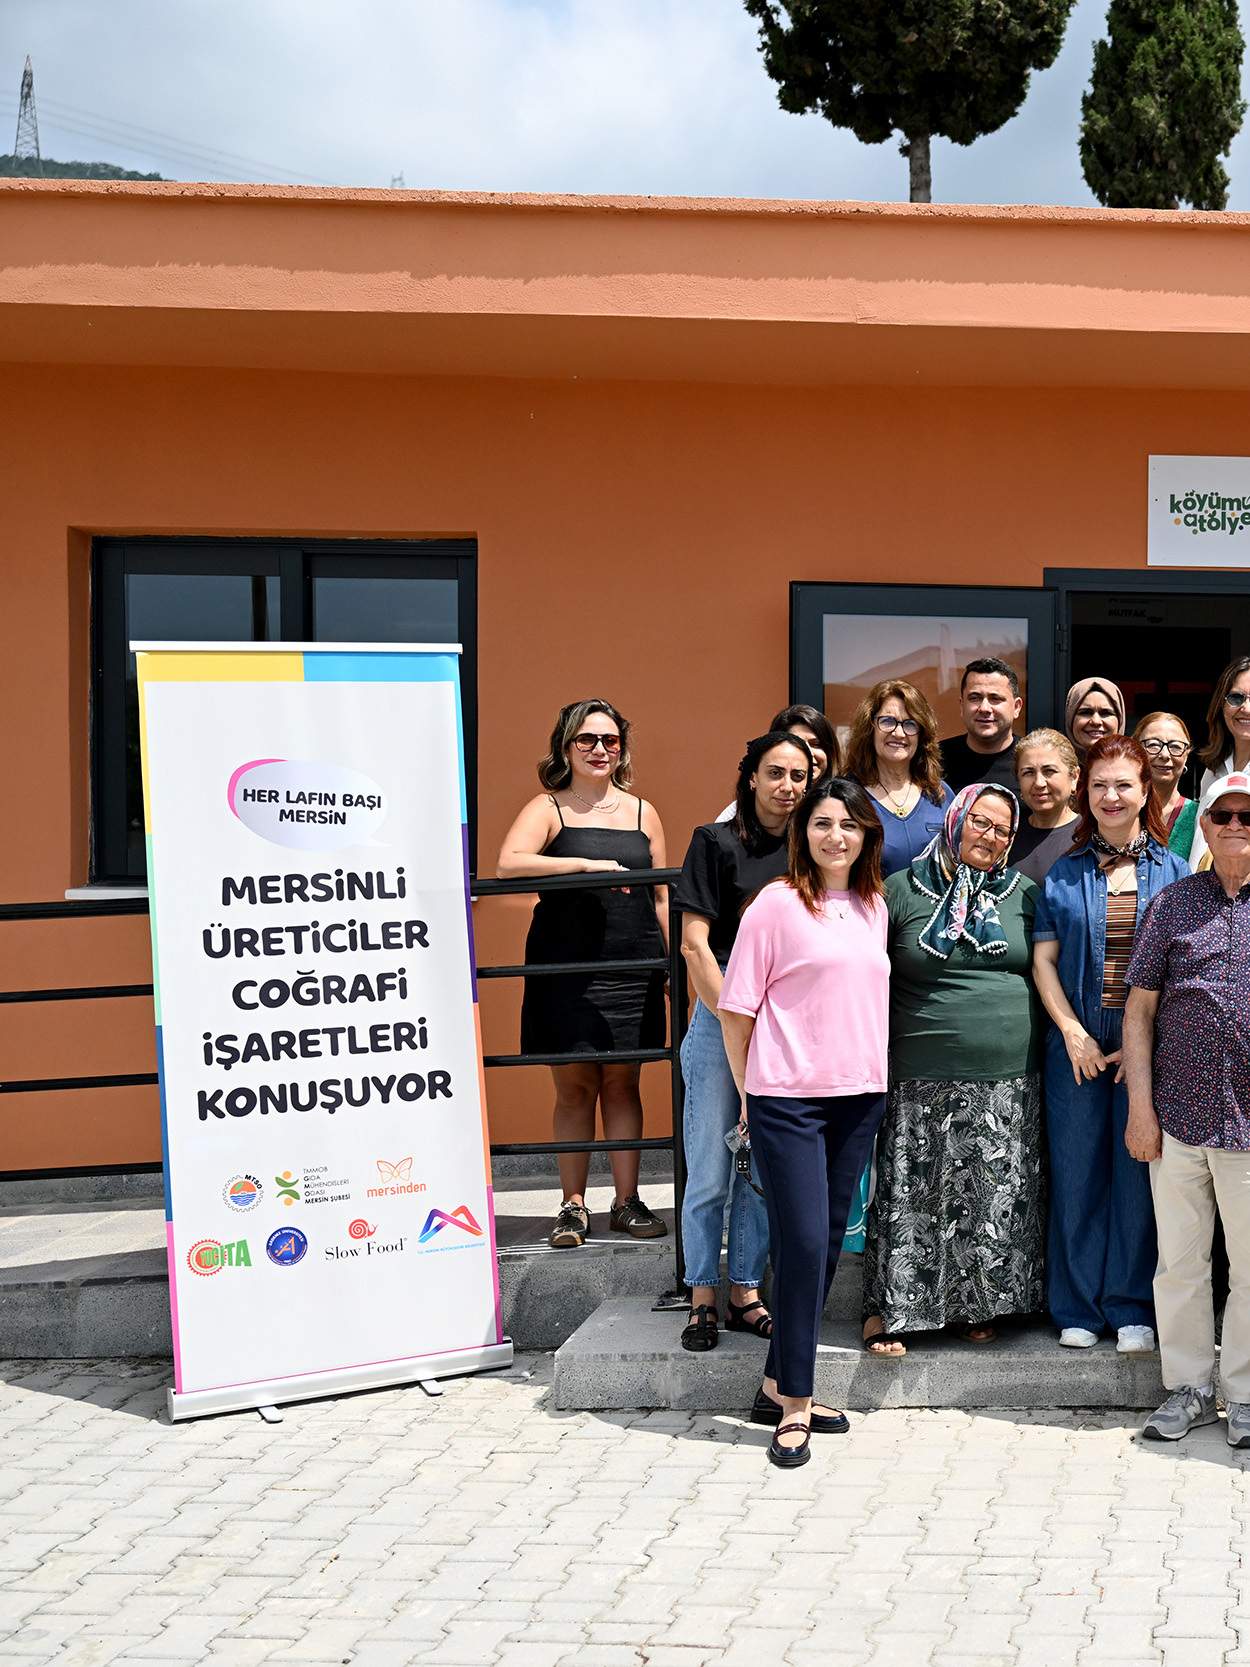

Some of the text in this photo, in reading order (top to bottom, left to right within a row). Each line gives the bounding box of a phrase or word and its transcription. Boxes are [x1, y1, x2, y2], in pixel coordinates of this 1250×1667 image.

[1108, 608, 1147, 618] MUTFAK
[242, 788, 381, 810] HER LAFIN BAŞI
[279, 808, 346, 825] MERSİN
[221, 866, 406, 906] MERSİNLİ
[202, 918, 430, 959] ÜRETİCİLER
[231, 967, 408, 1011] COĞRAFİ
[202, 1016, 429, 1071] İŞARETLERİ
[197, 1069, 453, 1121] KONUŞUYOR
[244, 1174, 263, 1190] MTSO
[367, 1182, 427, 1198] mersinden
[324, 1246, 361, 1261] Slow
